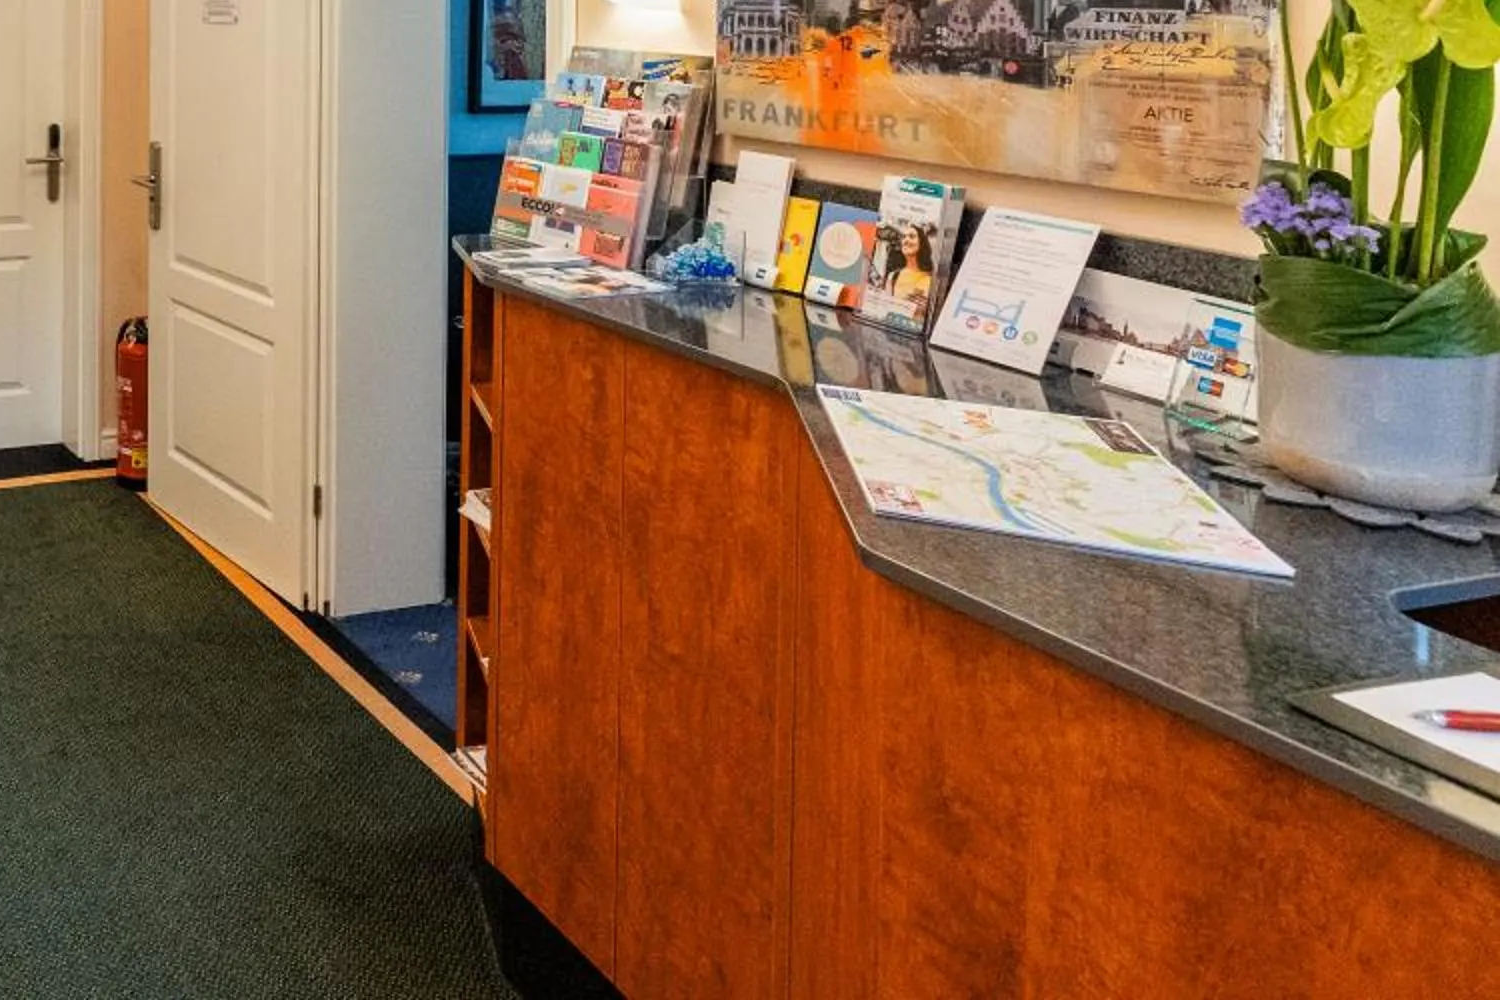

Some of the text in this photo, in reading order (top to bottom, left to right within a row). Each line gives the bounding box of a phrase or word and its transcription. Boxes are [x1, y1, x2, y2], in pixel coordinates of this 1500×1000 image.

[1094, 10, 1179, 25] FINANZ
[1065, 26, 1212, 45] WIRTSCHAFT
[723, 97, 928, 142] FRANKFURT
[1143, 105, 1194, 123] AKTIE
